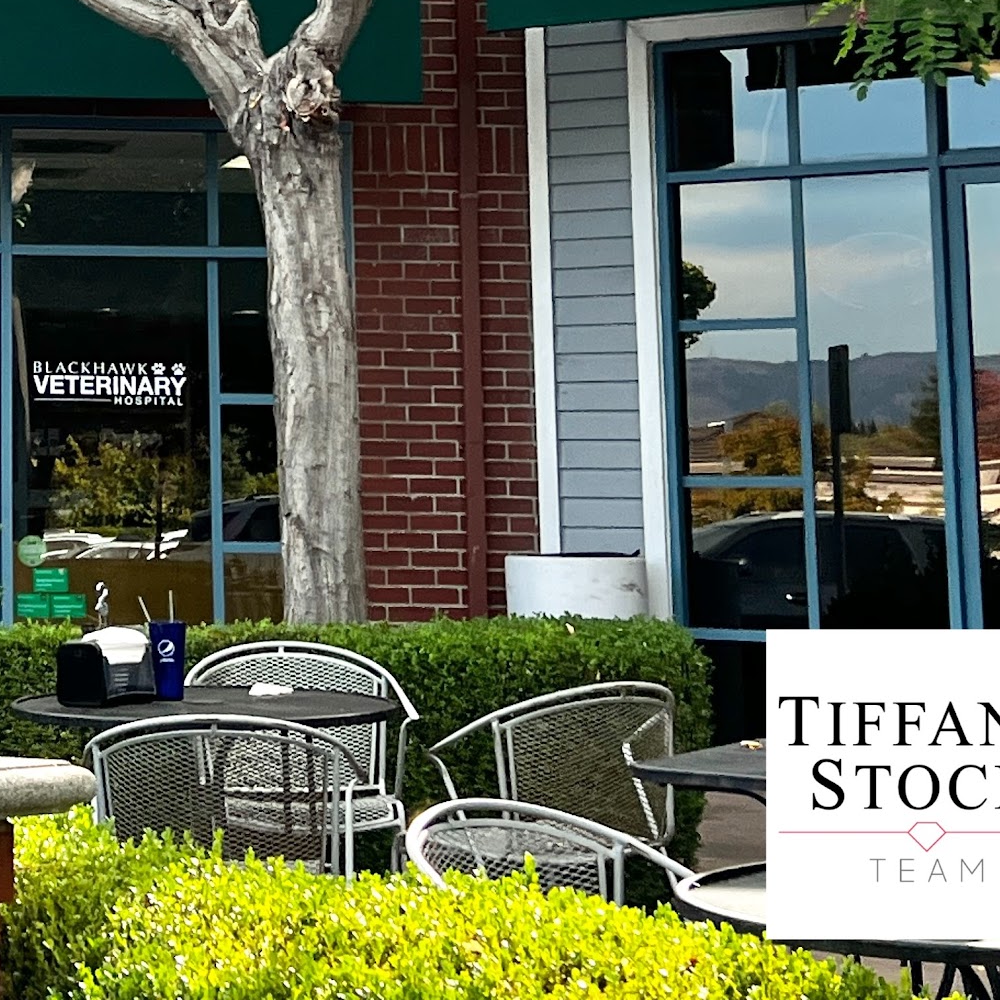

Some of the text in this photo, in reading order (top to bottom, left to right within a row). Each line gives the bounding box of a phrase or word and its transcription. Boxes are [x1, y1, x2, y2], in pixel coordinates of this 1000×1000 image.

[33, 361, 148, 375] BLACKHAWK
[33, 375, 187, 396] VETERINARY
[114, 396, 184, 406] HOSPITAL
